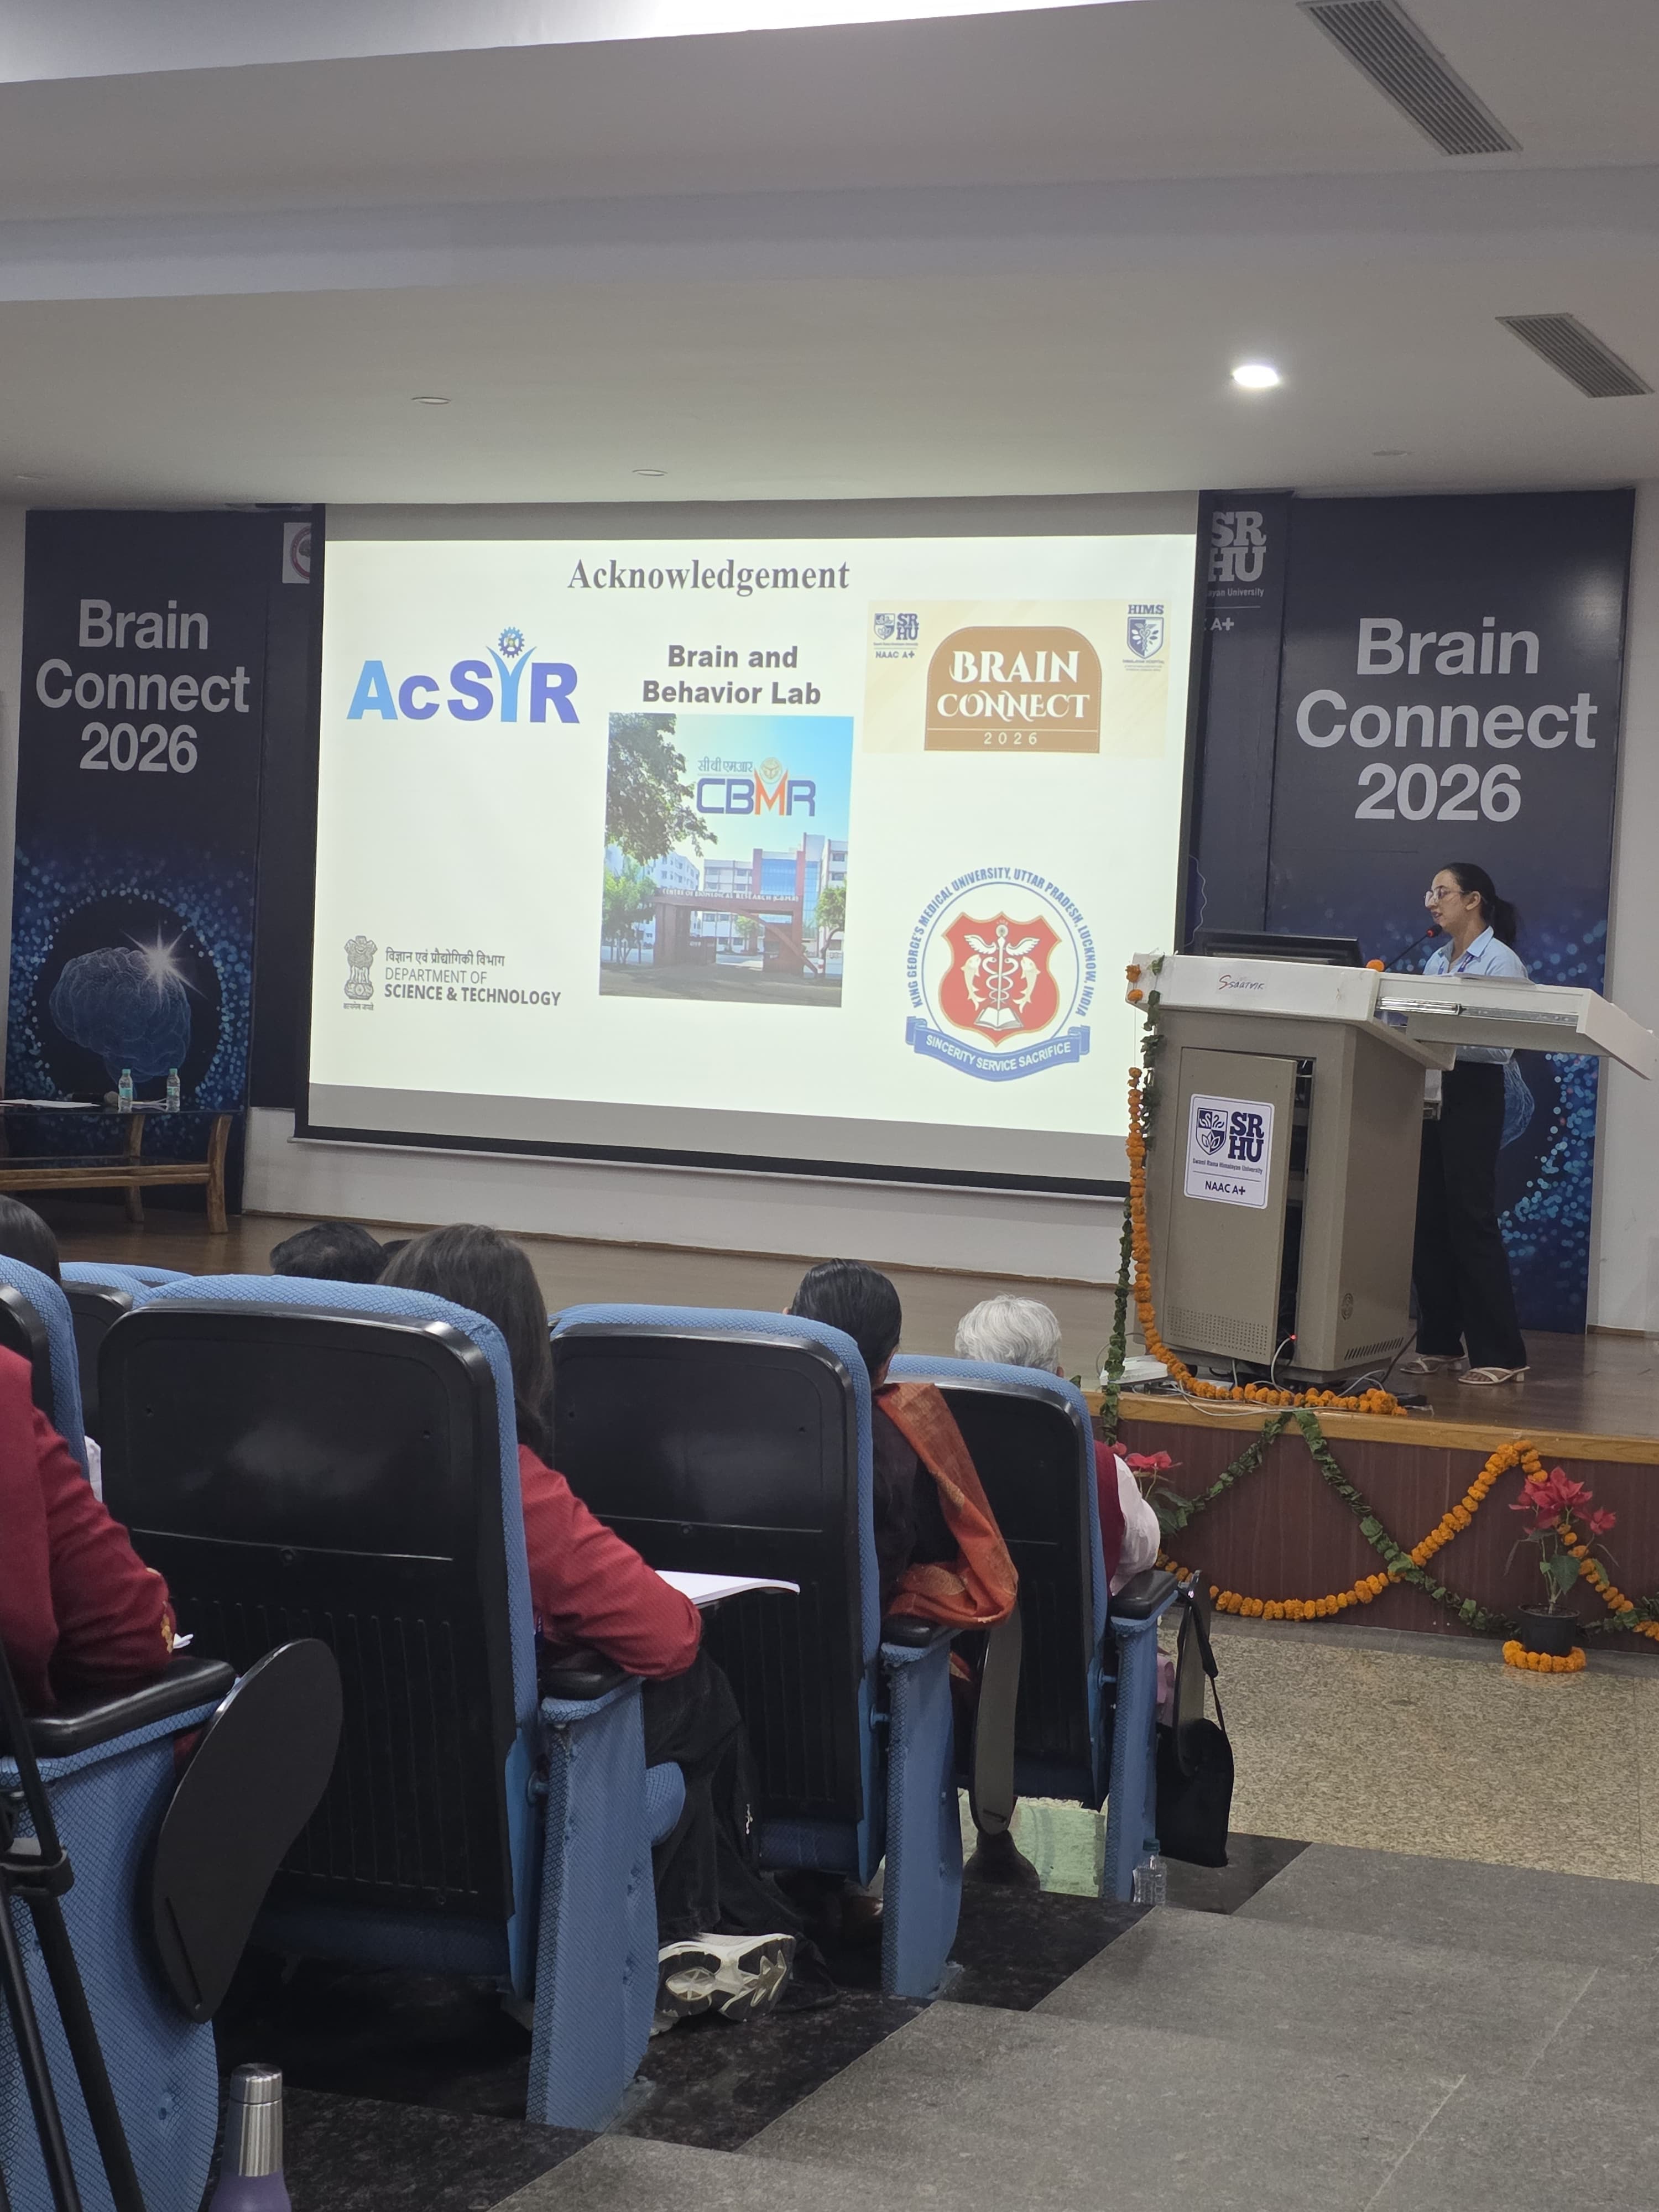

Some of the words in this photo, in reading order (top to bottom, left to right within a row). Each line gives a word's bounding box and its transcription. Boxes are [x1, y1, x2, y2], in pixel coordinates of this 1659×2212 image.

[567, 559, 849, 597] Acknowledgement
[1227, 588, 1264, 598] University
[897, 613, 919, 627] SR
[1128, 604, 1164, 614] HIMS
[79, 599, 208, 649] Brain
[896, 626, 919, 640] HU
[1210, 617, 1235, 631] A+
[668, 645, 738, 667] Brain
[748, 645, 798, 668] and
[902, 650, 915, 659] A+
[1357, 617, 1540, 675] Brain
[949, 650, 1080, 683] BRAIN
[36, 659, 250, 713] Connect
[643, 680, 762, 704] Behavior
[771, 682, 821, 705] Lab
[937, 690, 1090, 722] CONNECT
[1296, 689, 1598, 749] Connect
[80, 722, 198, 773] 2026
[984, 732, 1037, 745] 2026
[696, 768, 816, 817] CBMR
[1355, 763, 1521, 822] 2026
[1014, 868, 1046, 889] UTTAR
[919, 886, 953, 927] MEDICAL
[385, 947, 413, 963] विज्ञान
[415, 948, 428, 964] एवं
[431, 947, 473, 964] प्रौद्योगिकी
[476, 950, 505, 967] विभाग
[907, 926, 925, 978] GEORGE'S
[385, 967, 467, 983] DEPARTMENT
[471, 971, 487, 984] OF
[384, 984, 442, 1000] SCIENCE
[447, 987, 457, 1001] &
[461, 987, 561, 1006] TECHNOLOGY
[908, 980, 923, 1008] KING
[1075, 985, 1094, 1017] INDIA
[926, 1035, 975, 1065] SINCERITY
[976, 1057, 1017, 1071] SERVICE
[1019, 1042, 1071, 1067] SACRIFICE
[1230, 1112, 1265, 1138] SR
[1228, 1135, 1264, 1163] HU
[1205, 1181, 1230, 1193] NAAC
[1232, 1186, 1246, 1195] A+
